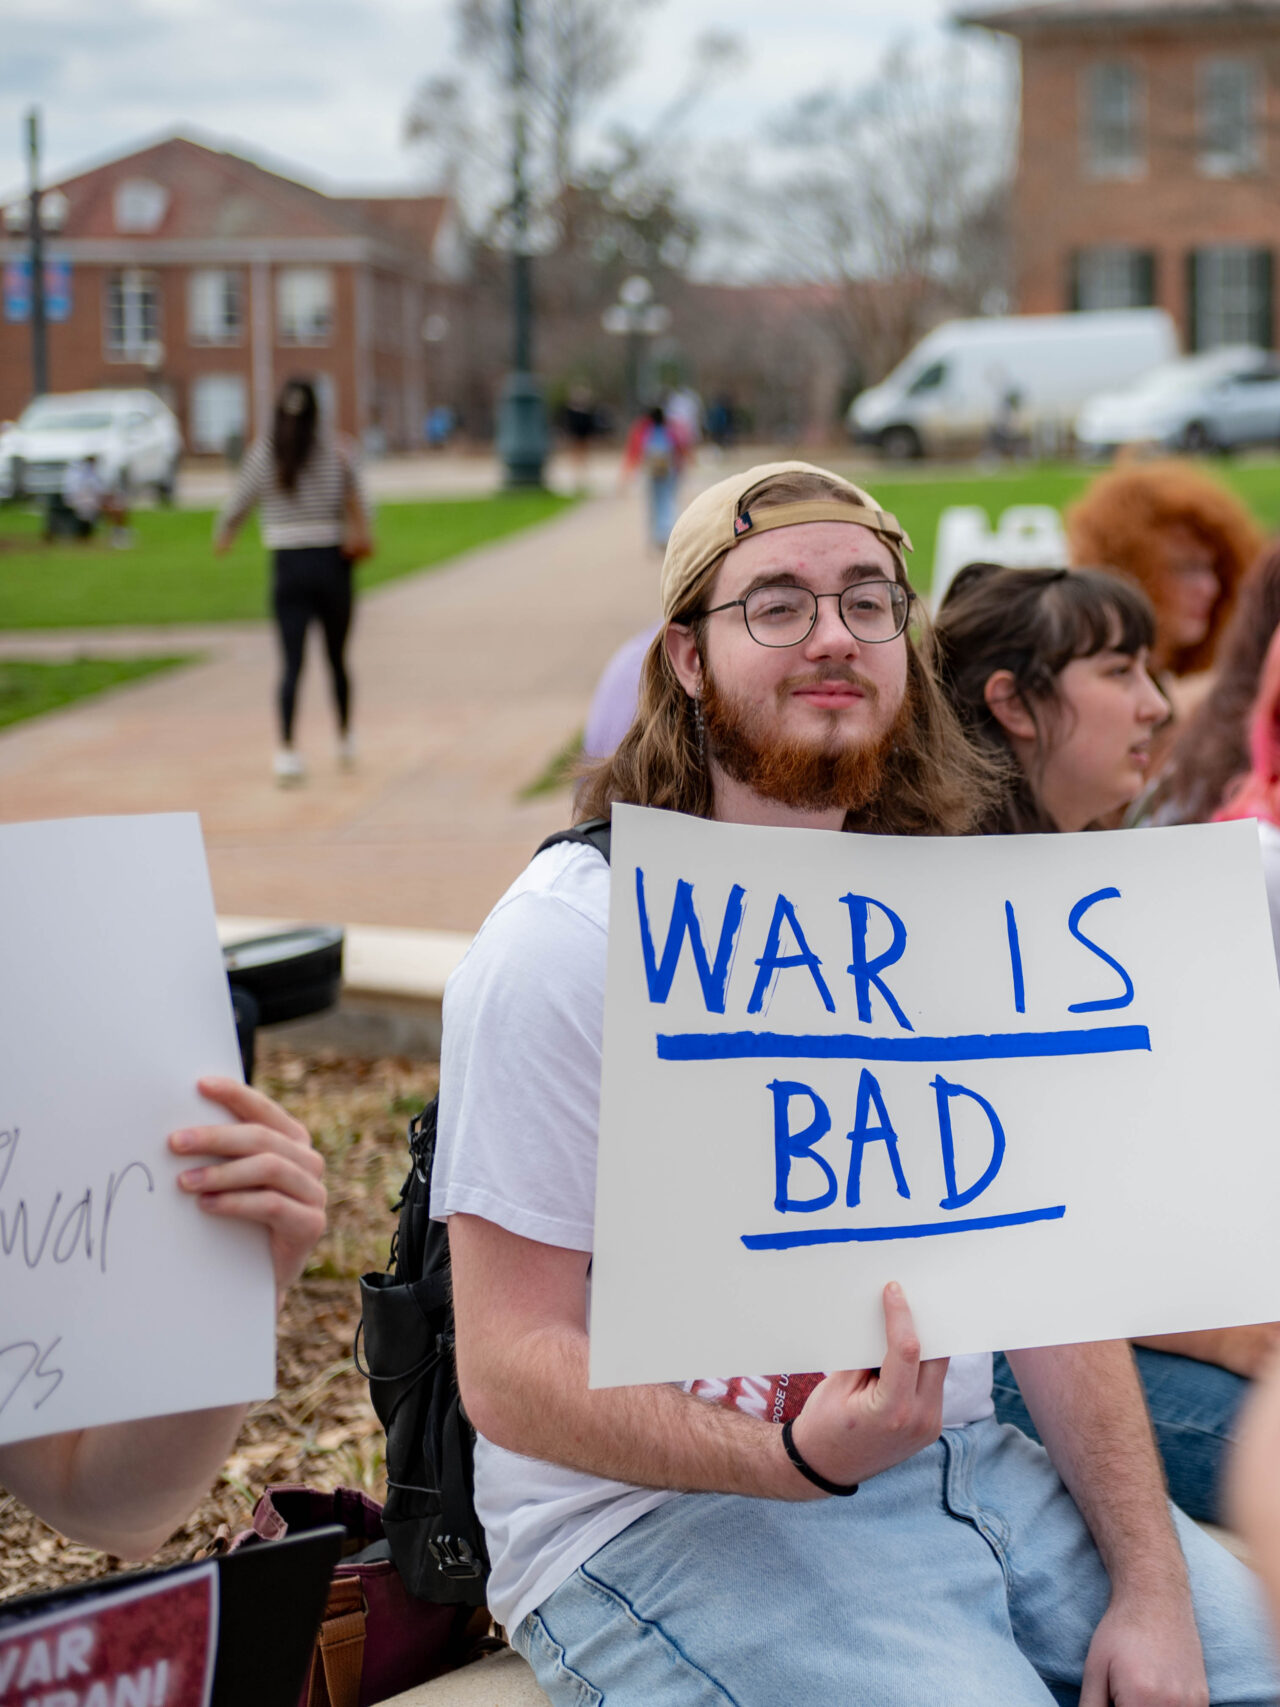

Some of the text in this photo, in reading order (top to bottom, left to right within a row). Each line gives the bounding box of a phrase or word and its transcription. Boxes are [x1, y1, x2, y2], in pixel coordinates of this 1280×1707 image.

[635, 866, 1136, 1033] WAR IS
[765, 1067, 1008, 1215] BAD
